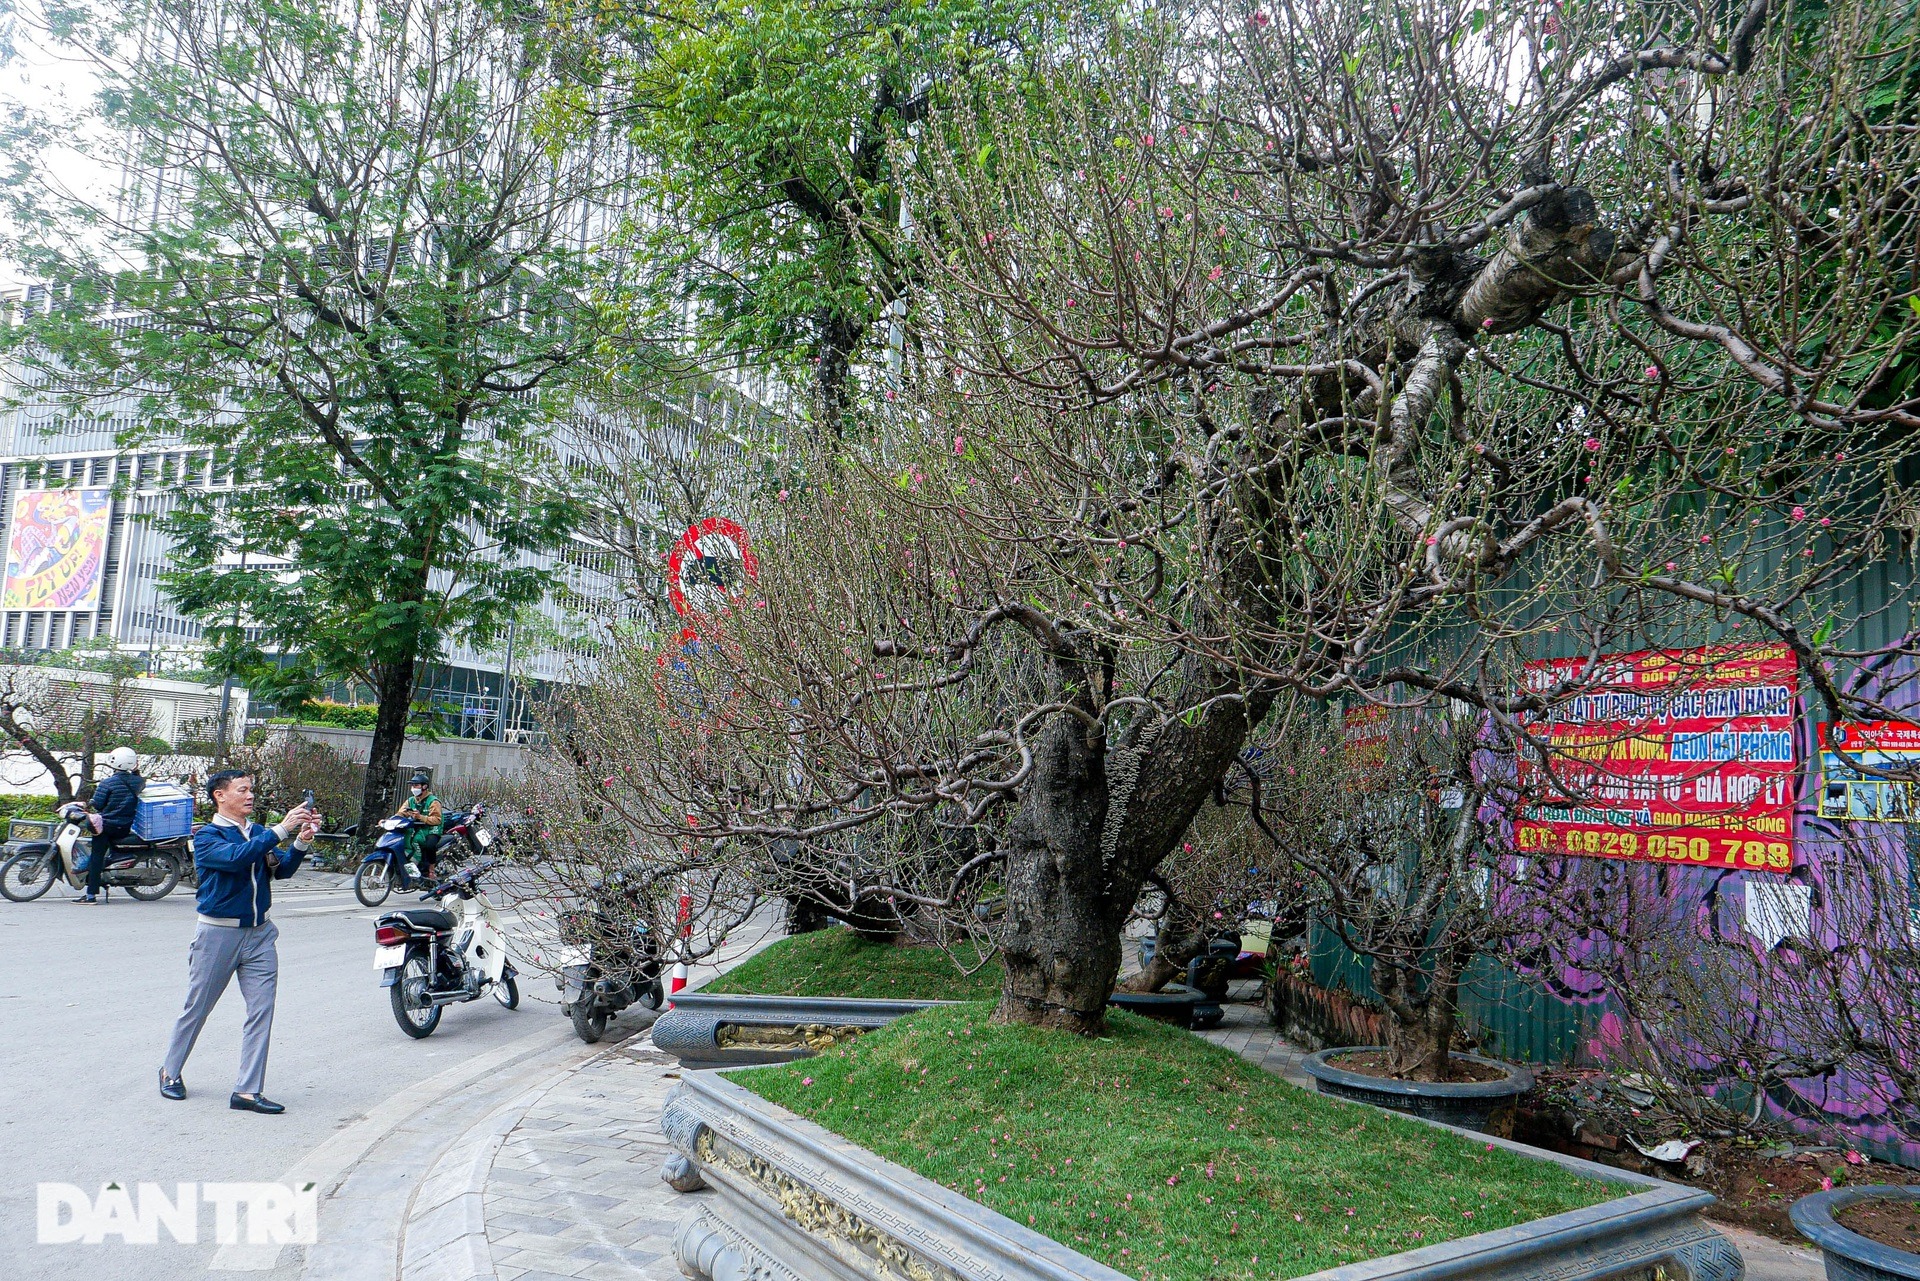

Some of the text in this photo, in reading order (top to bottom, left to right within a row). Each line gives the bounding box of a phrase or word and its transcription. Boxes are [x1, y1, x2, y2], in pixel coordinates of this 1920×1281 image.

[1750, 667, 1760, 678] 5
[1670, 689, 1702, 720] CÁC
[1704, 687, 1741, 718] GIAN
[1670, 731, 1709, 762] AEON
[1710, 723, 1738, 762] HẢI
[1738, 724, 1793, 763] PHÒNG
[1695, 770, 1723, 803] GIÁ
[1634, 806, 1653, 828] VÀ
[1653, 811, 1682, 826] GIAO
[1566, 829, 1638, 856] 0829
[1647, 835, 1710, 861] 050
[1720, 839, 1790, 868] 788
